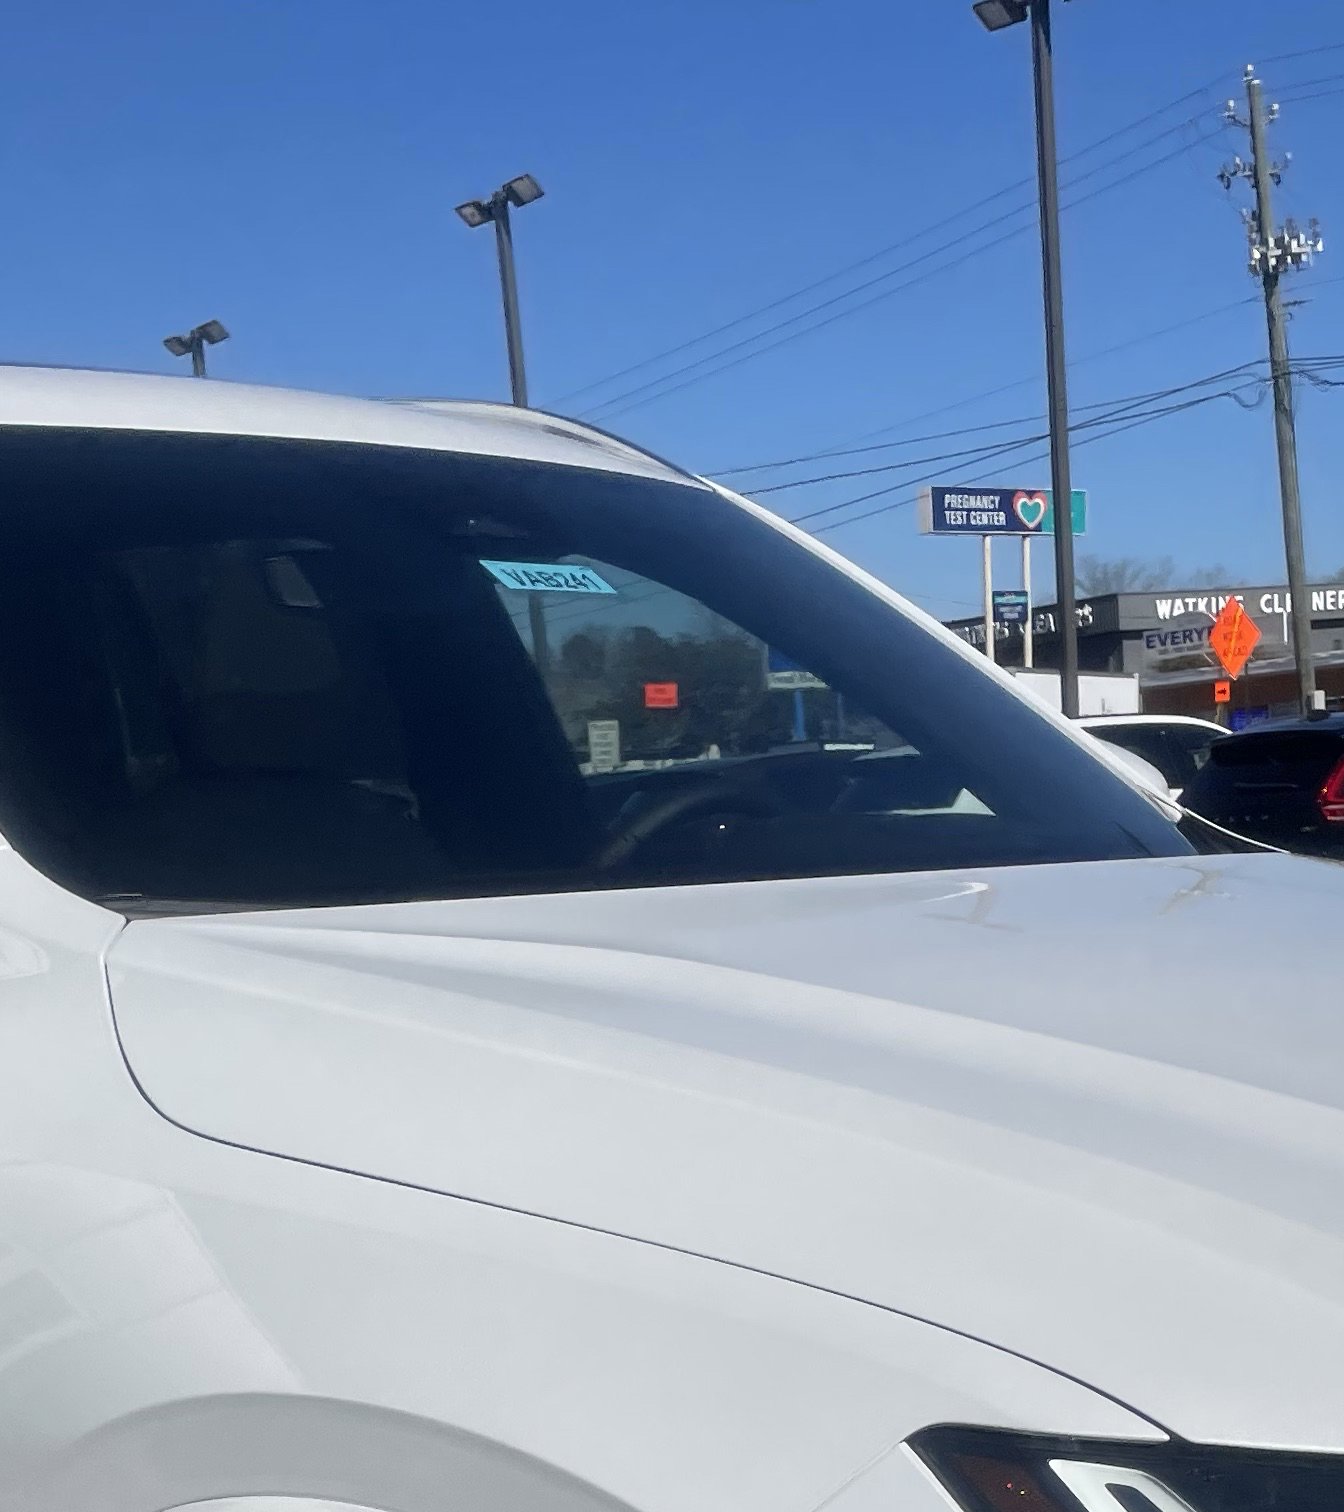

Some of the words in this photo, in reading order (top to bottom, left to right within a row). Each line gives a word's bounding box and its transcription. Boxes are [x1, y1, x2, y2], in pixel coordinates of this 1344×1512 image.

[943, 494, 1001, 509] PREGNANCY
[944, 510, 967, 525] TEST
[970, 511, 1006, 526] CENTER
[500, 568, 602, 591] VAB241
